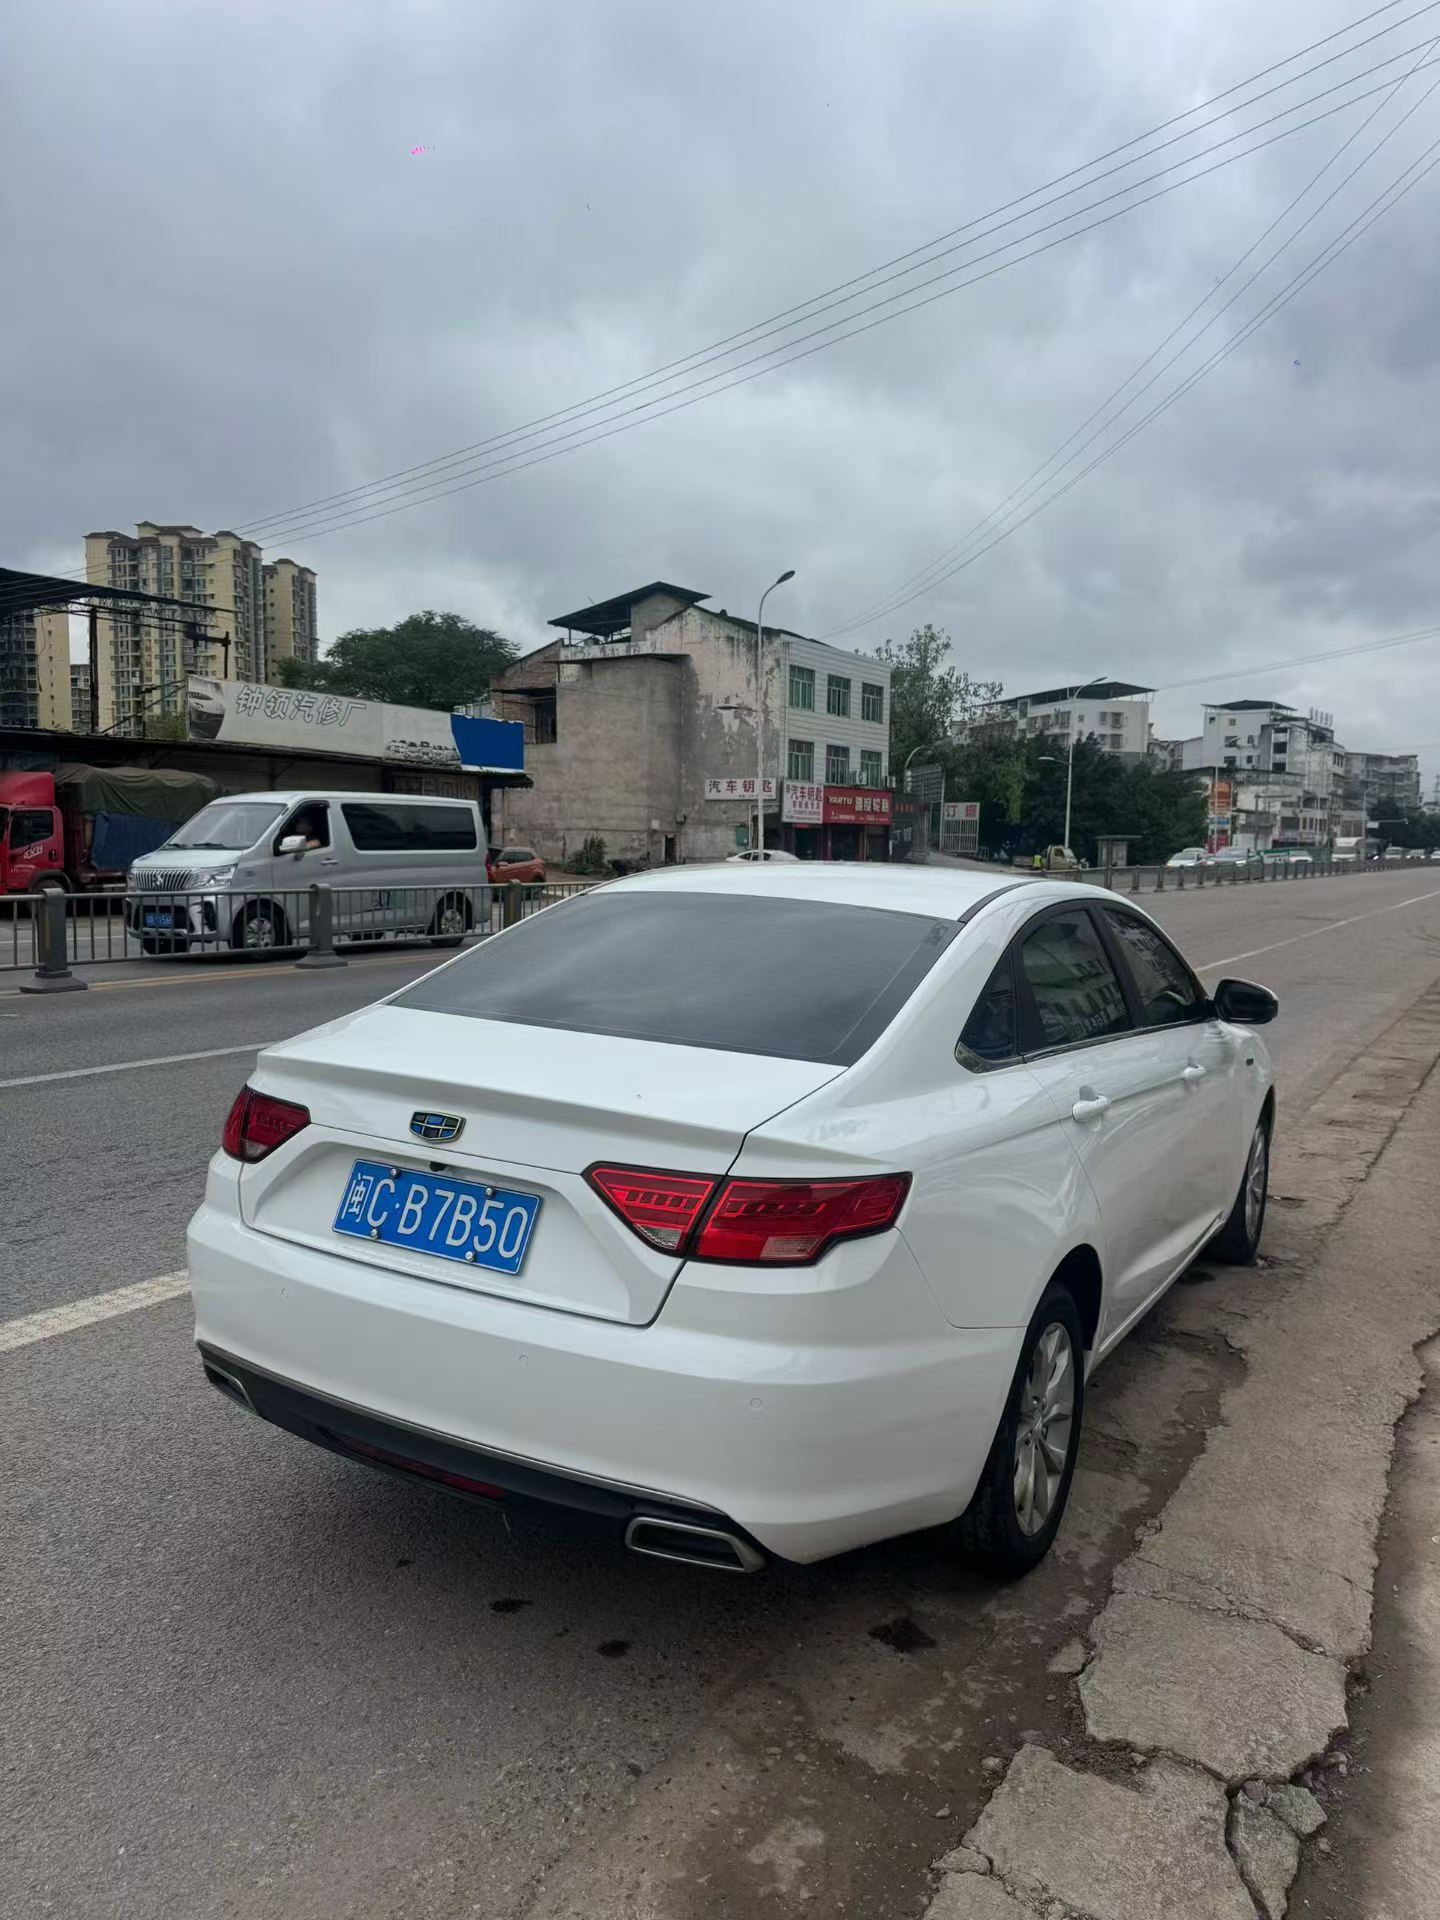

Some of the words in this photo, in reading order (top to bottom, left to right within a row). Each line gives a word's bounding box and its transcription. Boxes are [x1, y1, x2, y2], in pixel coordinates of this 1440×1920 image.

[236, 684, 367, 726] 钟领汽修厂
[708, 779, 773, 793] 汽车钥匙
[341, 1173, 529, 1260] 闽C·B7B50
